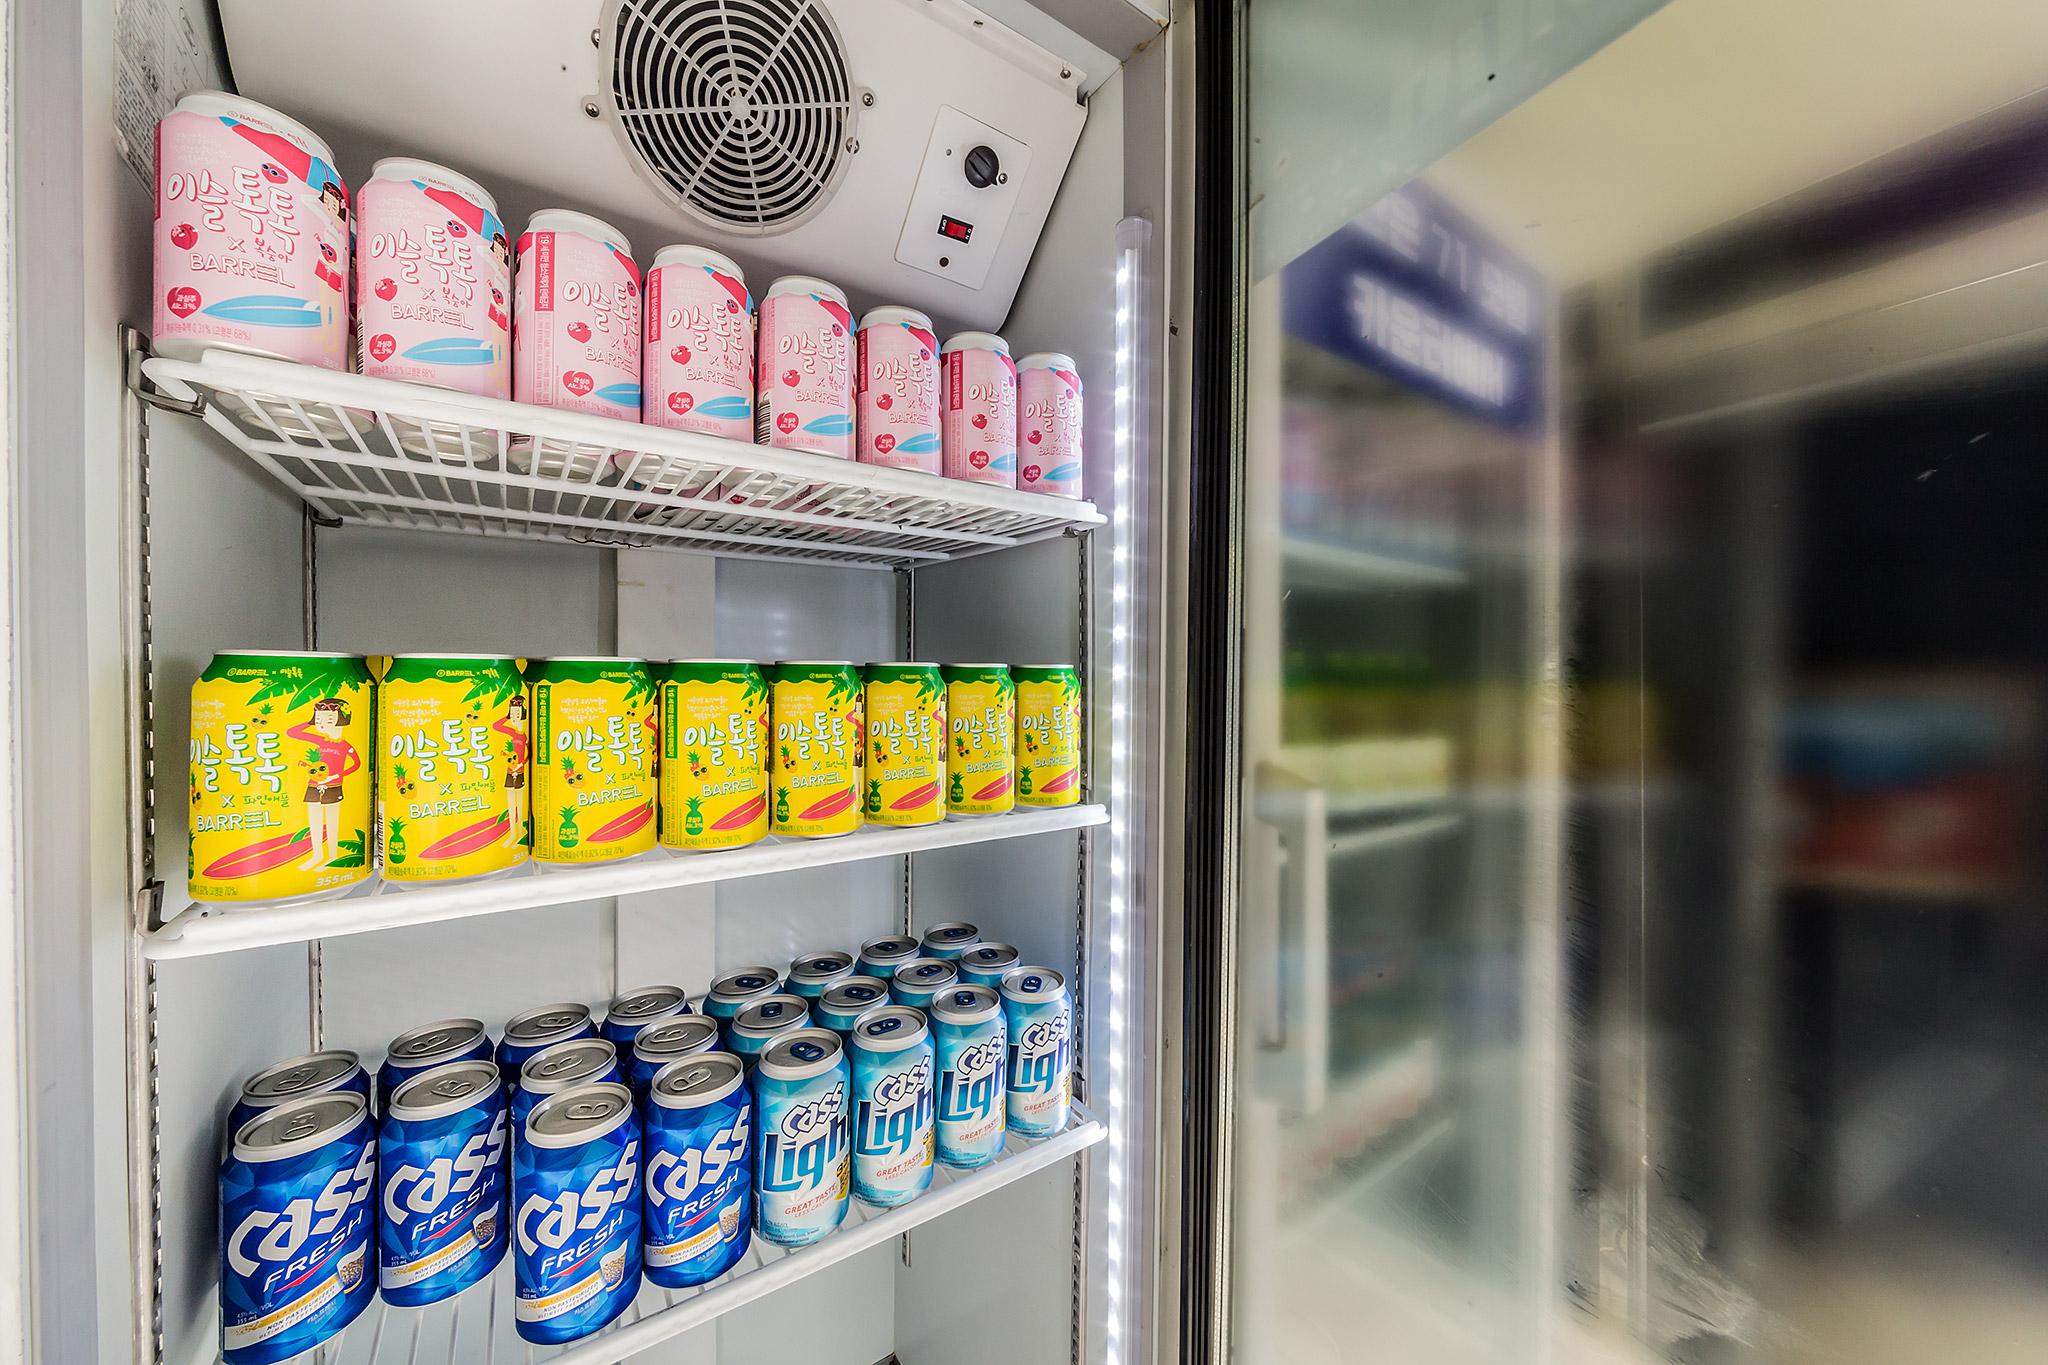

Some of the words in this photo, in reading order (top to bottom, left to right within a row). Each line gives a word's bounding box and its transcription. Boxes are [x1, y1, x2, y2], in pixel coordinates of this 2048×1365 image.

[167, 165, 300, 255] 이슬톡톡
[190, 252, 296, 289] BARREL
[371, 224, 477, 300] 이슬톡톡
[391, 303, 474, 330] BARREL
[667, 303, 744, 365] 이슬톡톡
[686, 367, 742, 390] BARREL
[779, 328, 847, 385] 이슬톡톡
[795, 389, 846, 408] BARREL
[873, 353, 934, 407] 이슬톡톡
[391, 719, 494, 780] 이슬톡톡
[557, 716, 645, 770] 이슬톡톡
[684, 713, 759, 764] 이슬톡톡
[778, 712, 846, 760] 이슬톡톡
[871, 710, 933, 754] 이슬톡톡
[953, 708, 1009, 749] 이슬톡톡
[1022, 706, 1073, 751] 이슬톡톡
[578, 784, 642, 807] BARREL
[702, 778, 757, 797] BARREL
[792, 772, 845, 788] BARREL
[883, 766, 931, 781] BARREL
[196, 811, 281, 832] BARREL
[409, 796, 491, 819] BARREL
[957, 1028, 1005, 1075] Cass
[1021, 1009, 1069, 1050] Cass
[873, 1055, 931, 1106] Cass
[781, 1081, 845, 1139] Cass
[1024, 1102, 1045, 1112] GREAT
[959, 1130, 982, 1142] GREAT
[876, 1166, 901, 1177] GREAT
[903, 1150, 923, 1169] TASTE
[412, 1172, 496, 1240] FRESH
[667, 1168, 739, 1225] FRESH
[784, 1200, 813, 1215] GREAT
[815, 1182, 836, 1203] TASTE
[264, 1208, 363, 1293] FRESH
[541, 1209, 624, 1275] FRESH
